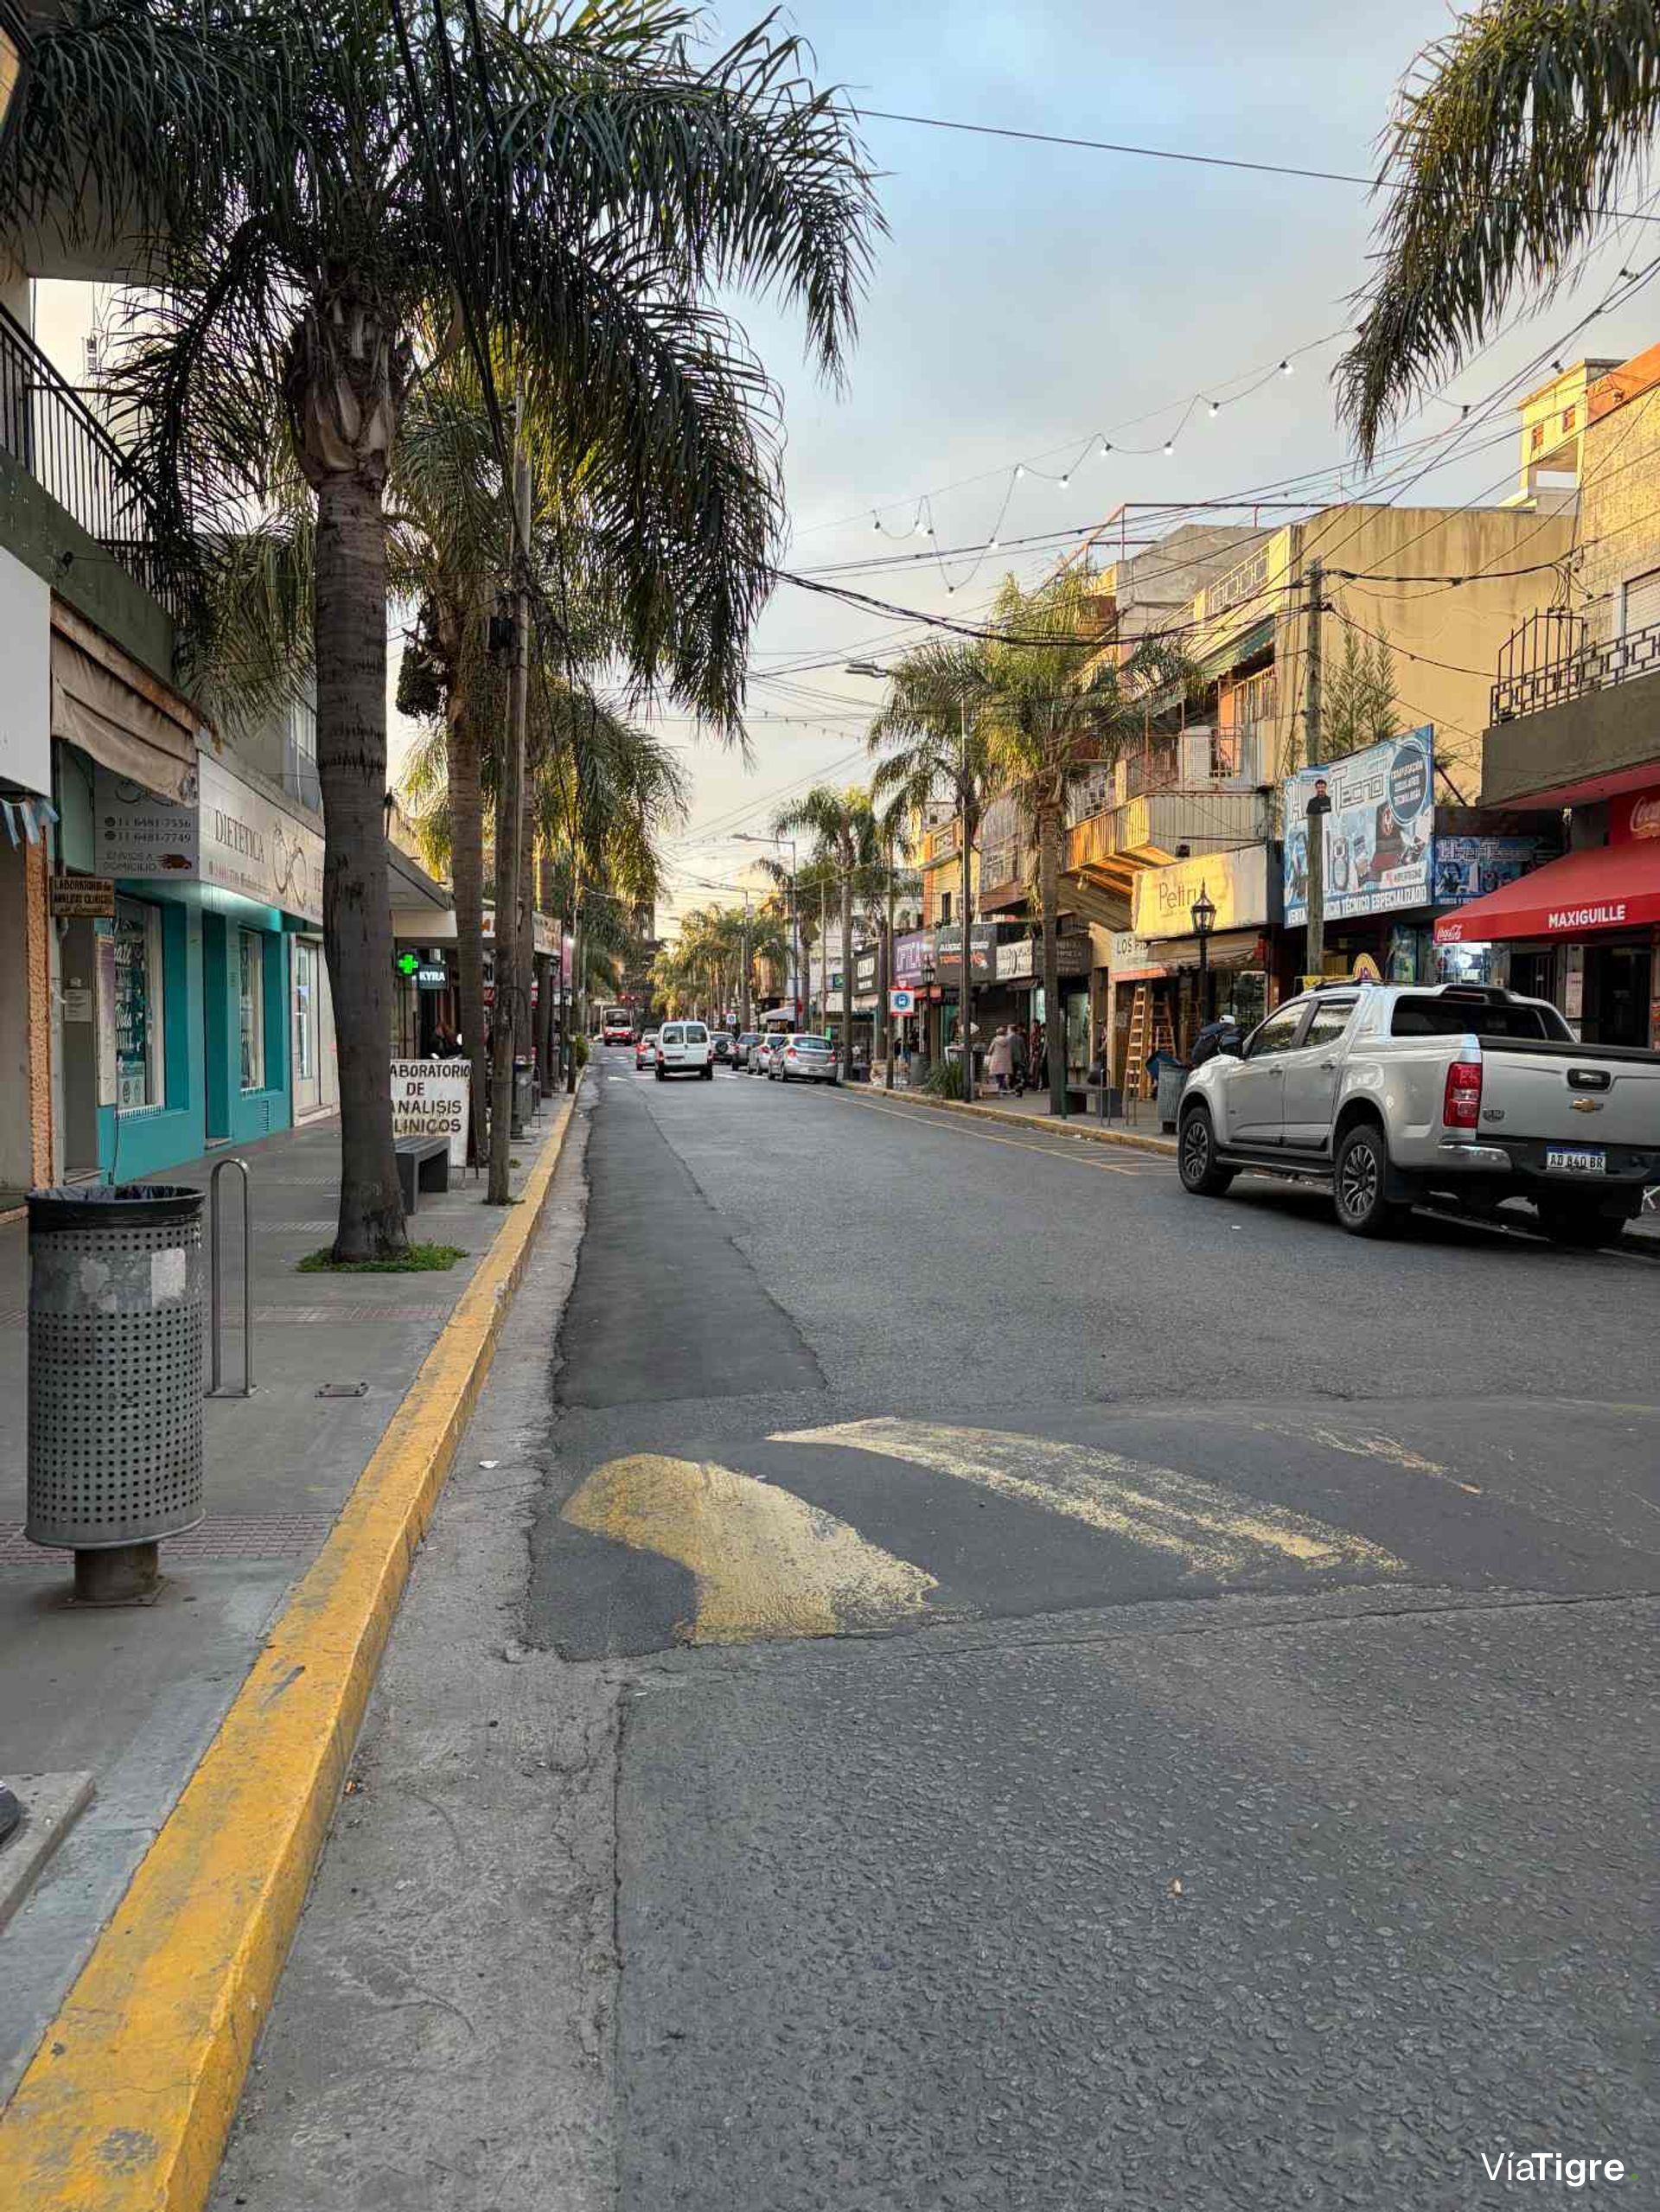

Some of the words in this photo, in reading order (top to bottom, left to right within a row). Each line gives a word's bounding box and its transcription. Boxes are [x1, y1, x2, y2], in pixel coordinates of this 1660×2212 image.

[1371, 885, 1427, 910] ESPECIALIZADO
[1548, 904, 1625, 928] MAXIGUILLE
[418, 971, 446, 982] KYRA
[389, 1064, 471, 1078] ABORATORIO
[406, 1082, 425, 1096] DE
[393, 1119, 463, 1134] LINICOS
